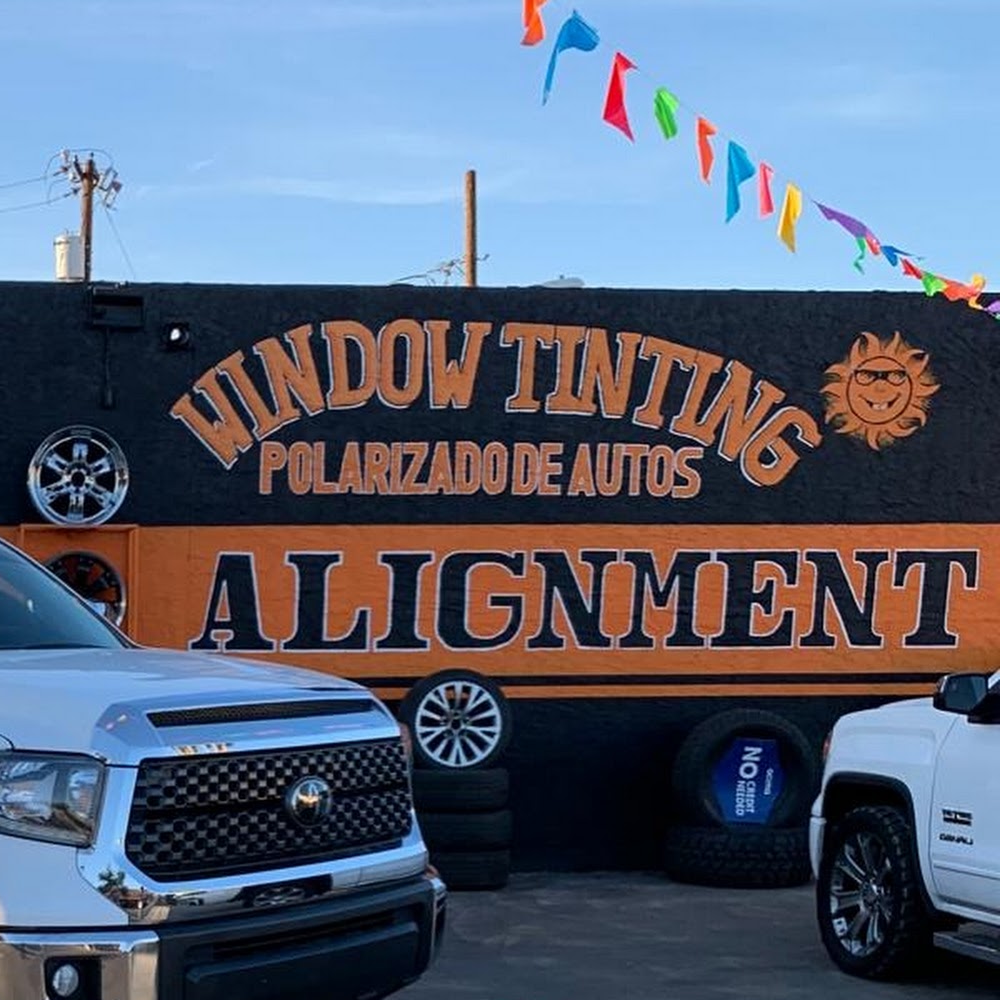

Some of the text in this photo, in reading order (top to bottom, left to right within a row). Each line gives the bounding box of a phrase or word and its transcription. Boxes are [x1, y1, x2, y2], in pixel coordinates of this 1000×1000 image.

[169, 319, 823, 487] WINDOW TINTING
[567, 442, 704, 498] AUTOS
[189, 549, 980, 654] ALIGNMENT
[739, 746, 763, 779] NO
